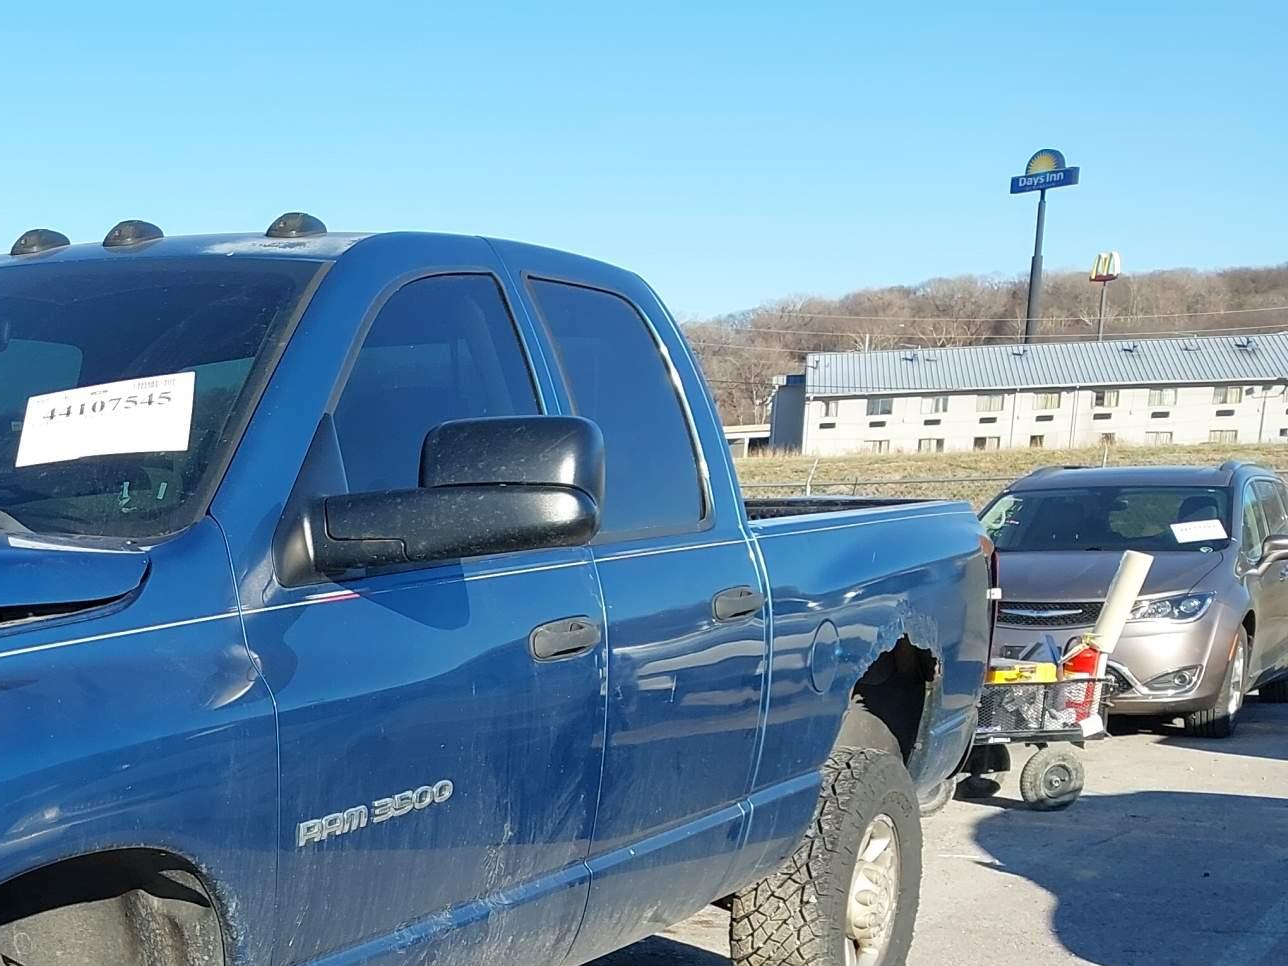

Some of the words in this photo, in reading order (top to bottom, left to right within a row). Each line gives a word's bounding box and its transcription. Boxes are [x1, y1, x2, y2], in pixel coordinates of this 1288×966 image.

[1018, 175, 1045, 187] Days
[1046, 171, 1064, 183] Inn
[42, 391, 172, 421] 44107545
[296, 804, 368, 847] RAM
[371, 779, 454, 824] 3500
